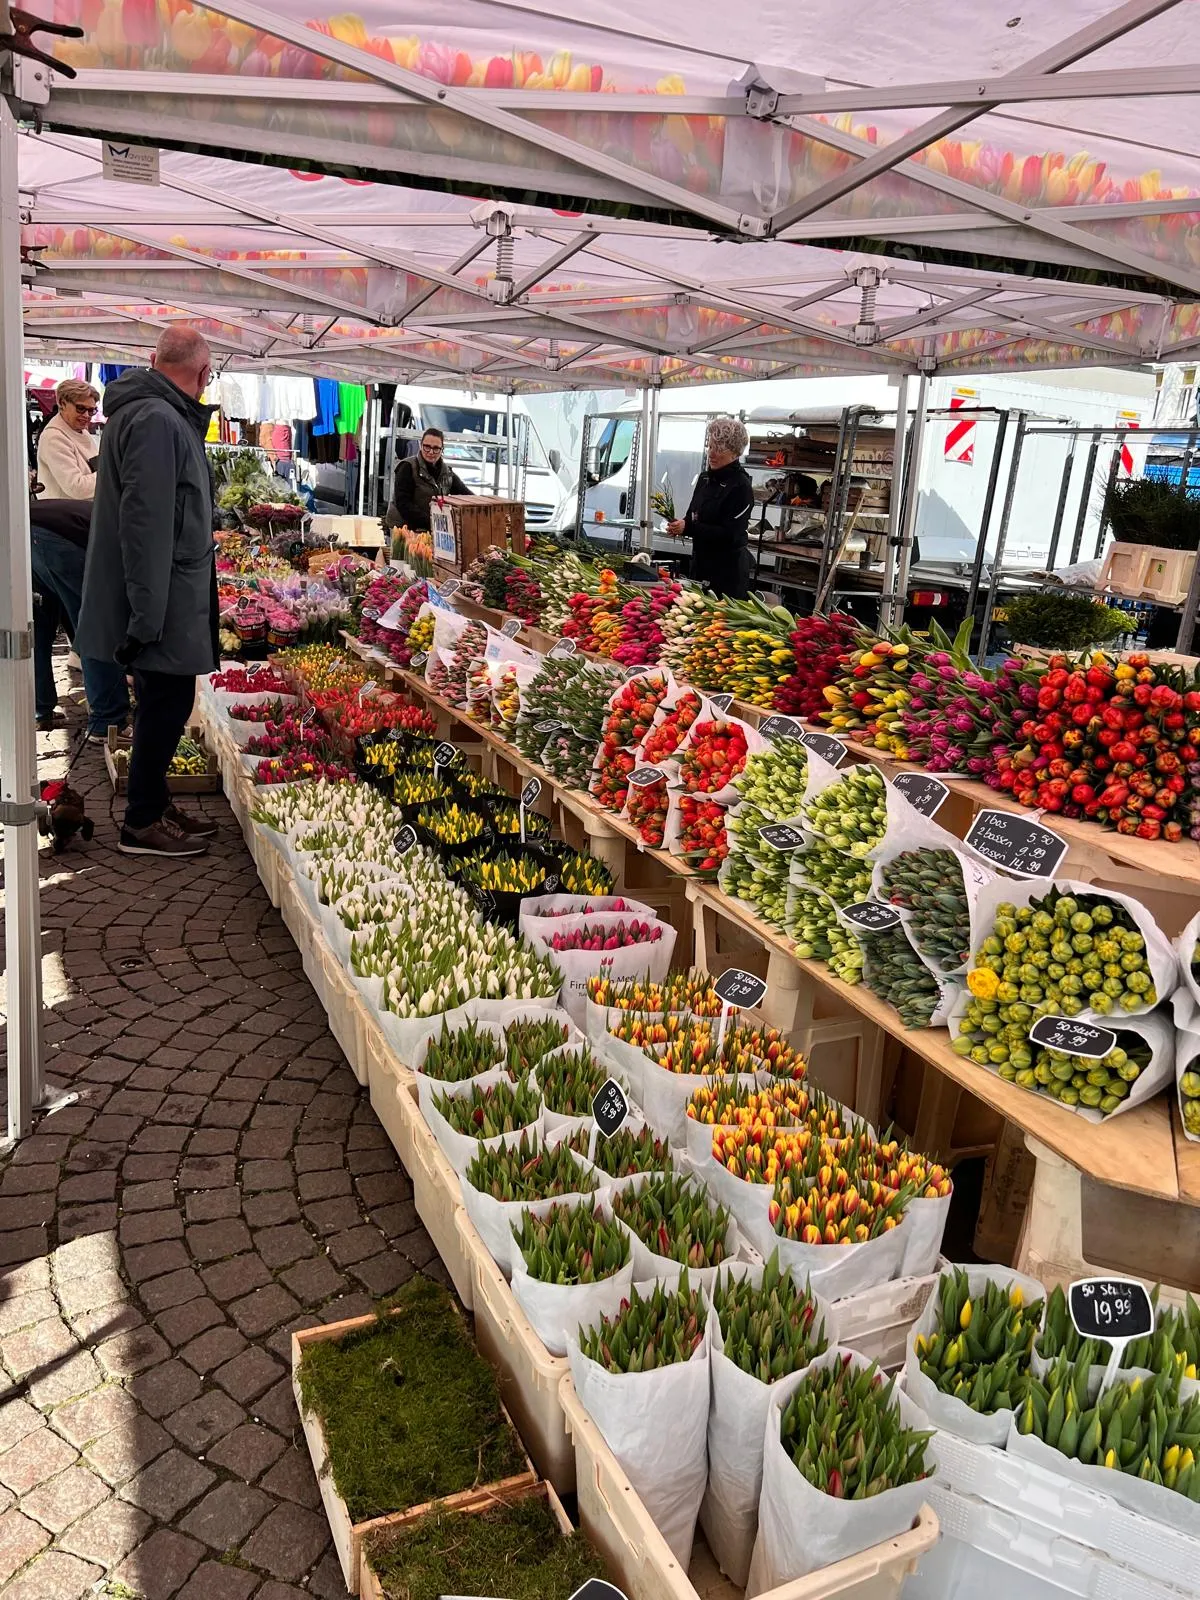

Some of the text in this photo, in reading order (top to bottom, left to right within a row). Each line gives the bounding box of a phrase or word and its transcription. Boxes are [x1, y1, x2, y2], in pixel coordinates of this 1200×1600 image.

[984, 815, 1055, 846] 1 bos 5.50
[977, 826, 1047, 859] 2 bossen 9.99
[970, 838, 1042, 873] 3 bossen 14.99
[734, 972, 745, 980] 50
[724, 982, 752, 997] 19.99
[1055, 1020, 1071, 1031] 50
[608, 1087, 617, 1098] 50
[600, 1100, 617, 1119] 19.99
[1081, 1283, 1095, 1298] 50
[1094, 1298, 1132, 1325] 19.99
